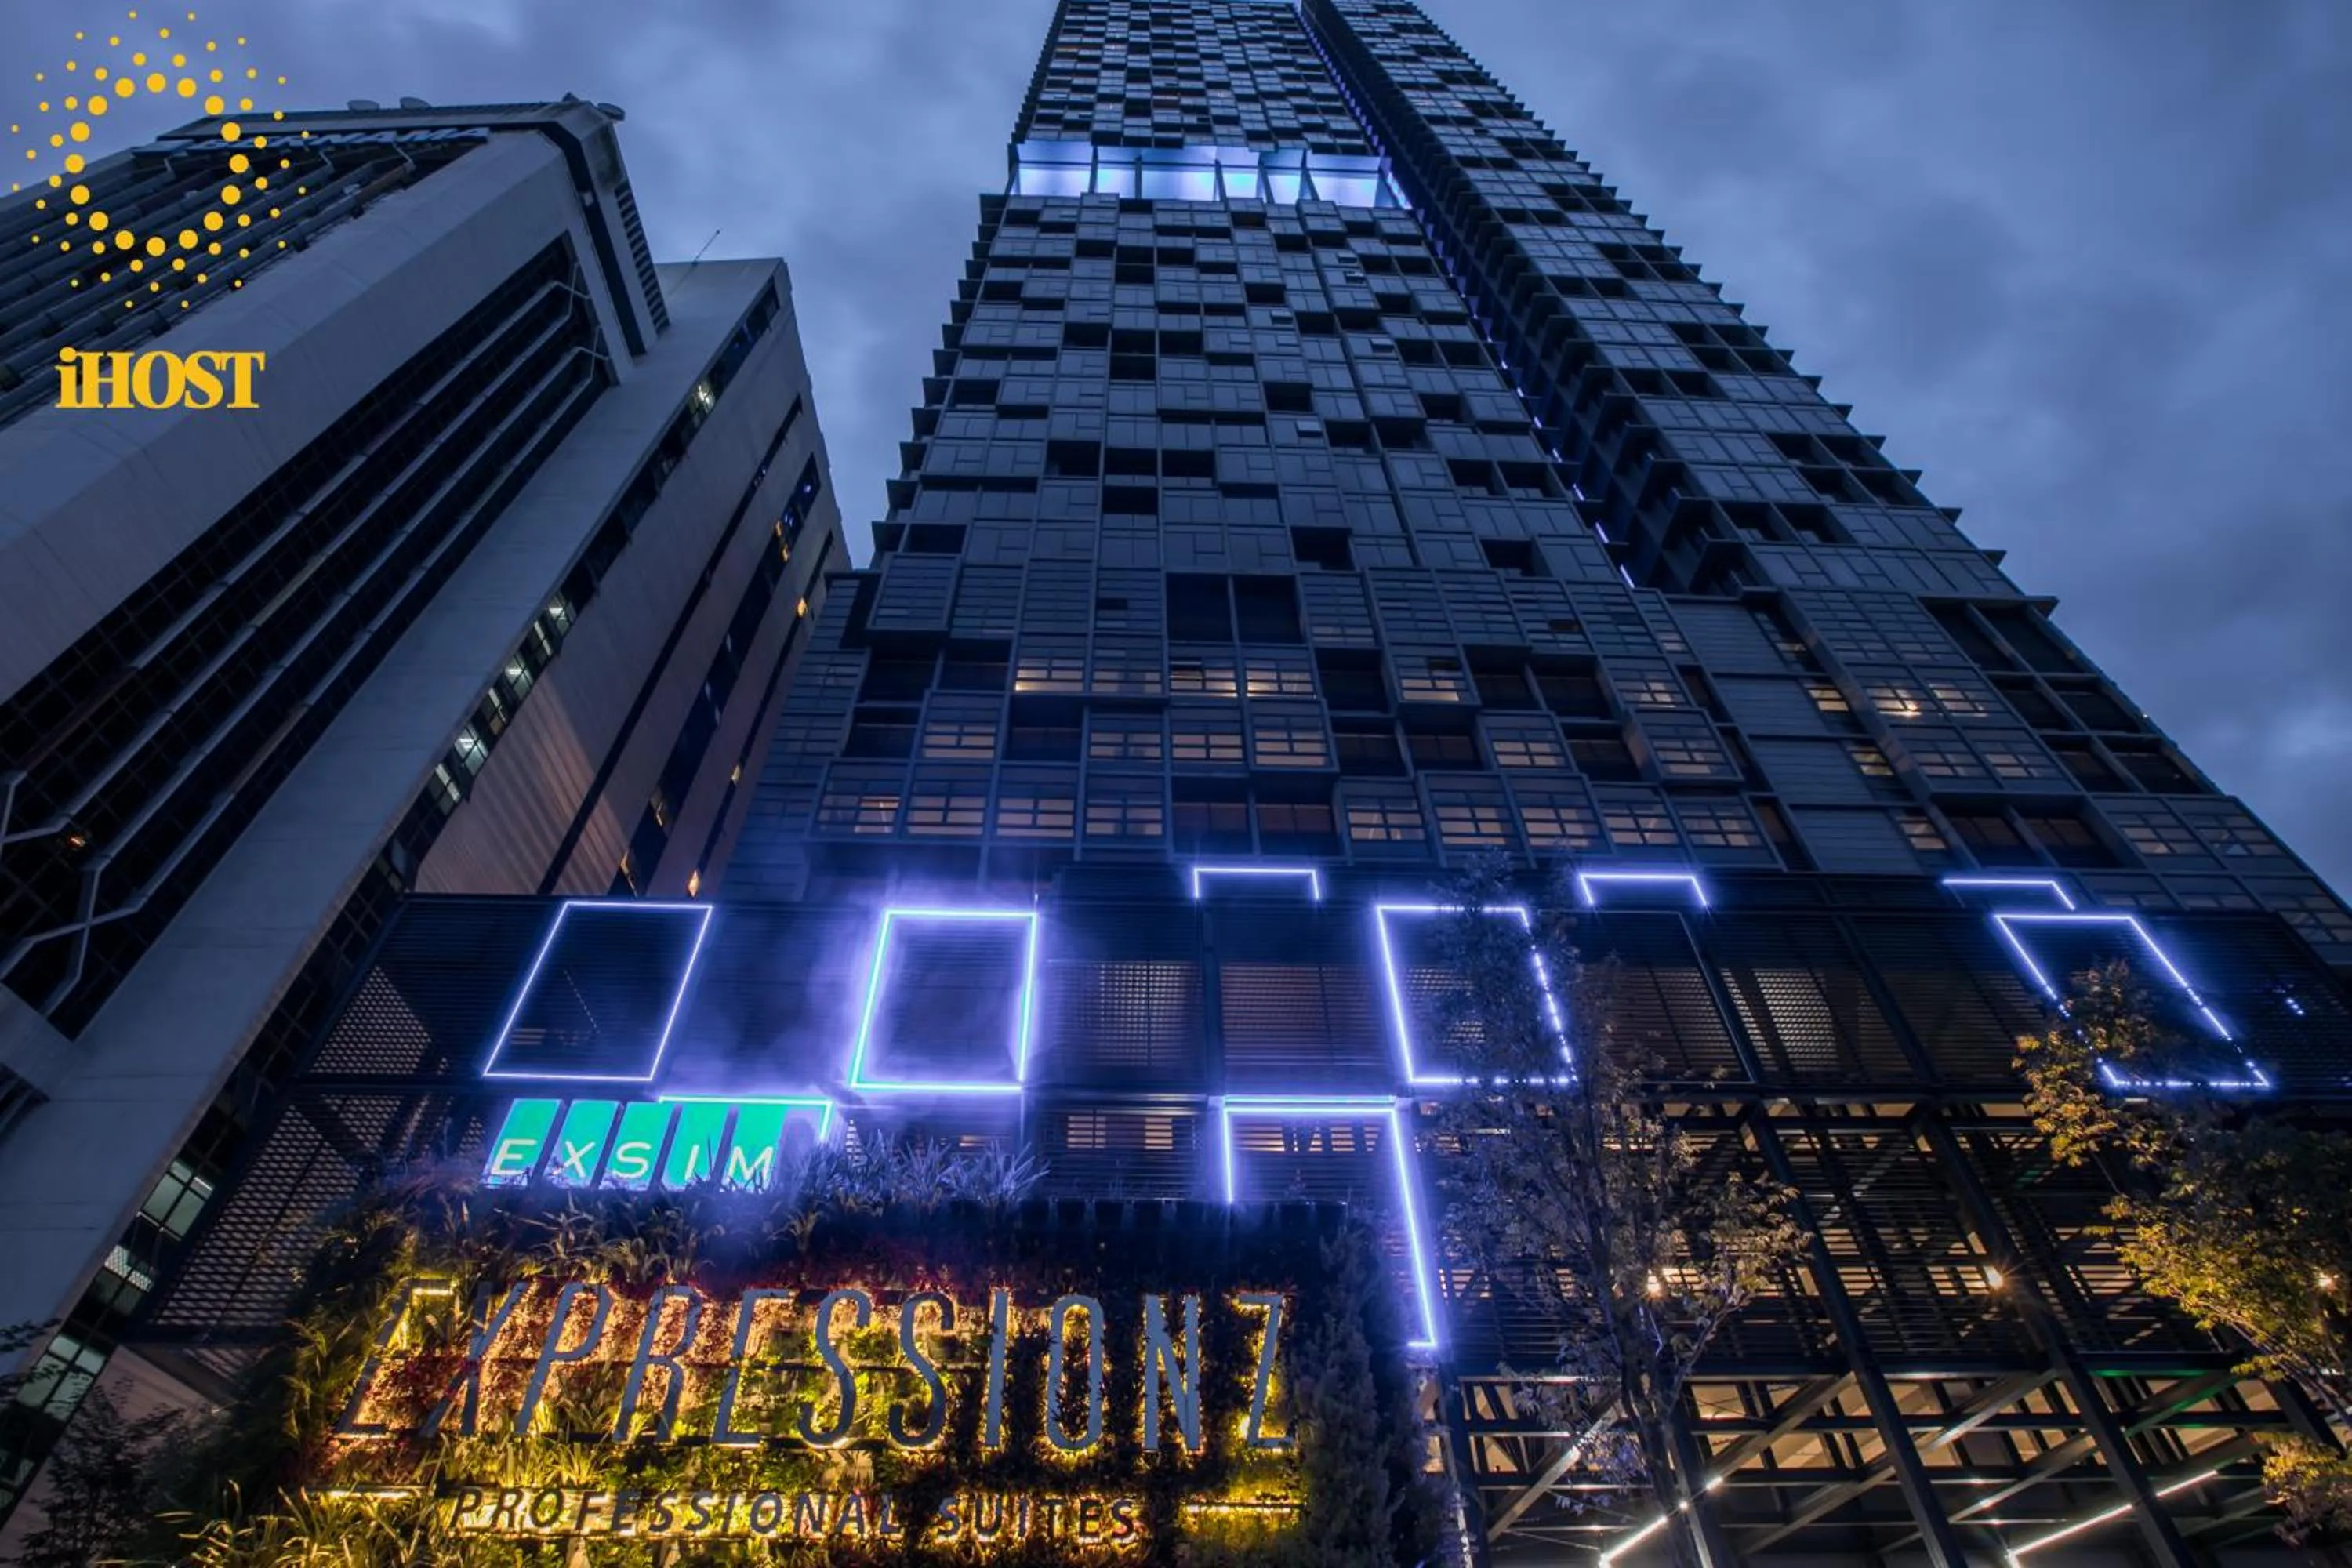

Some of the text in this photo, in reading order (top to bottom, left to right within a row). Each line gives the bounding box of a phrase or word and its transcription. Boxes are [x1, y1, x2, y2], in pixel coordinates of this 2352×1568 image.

[490, 1138, 773, 1182] EXSIM
[337, 1279, 1294, 1450] EXPRESSIONZ
[448, 1489, 1135, 1541] PROFESSIONAL SUITES
